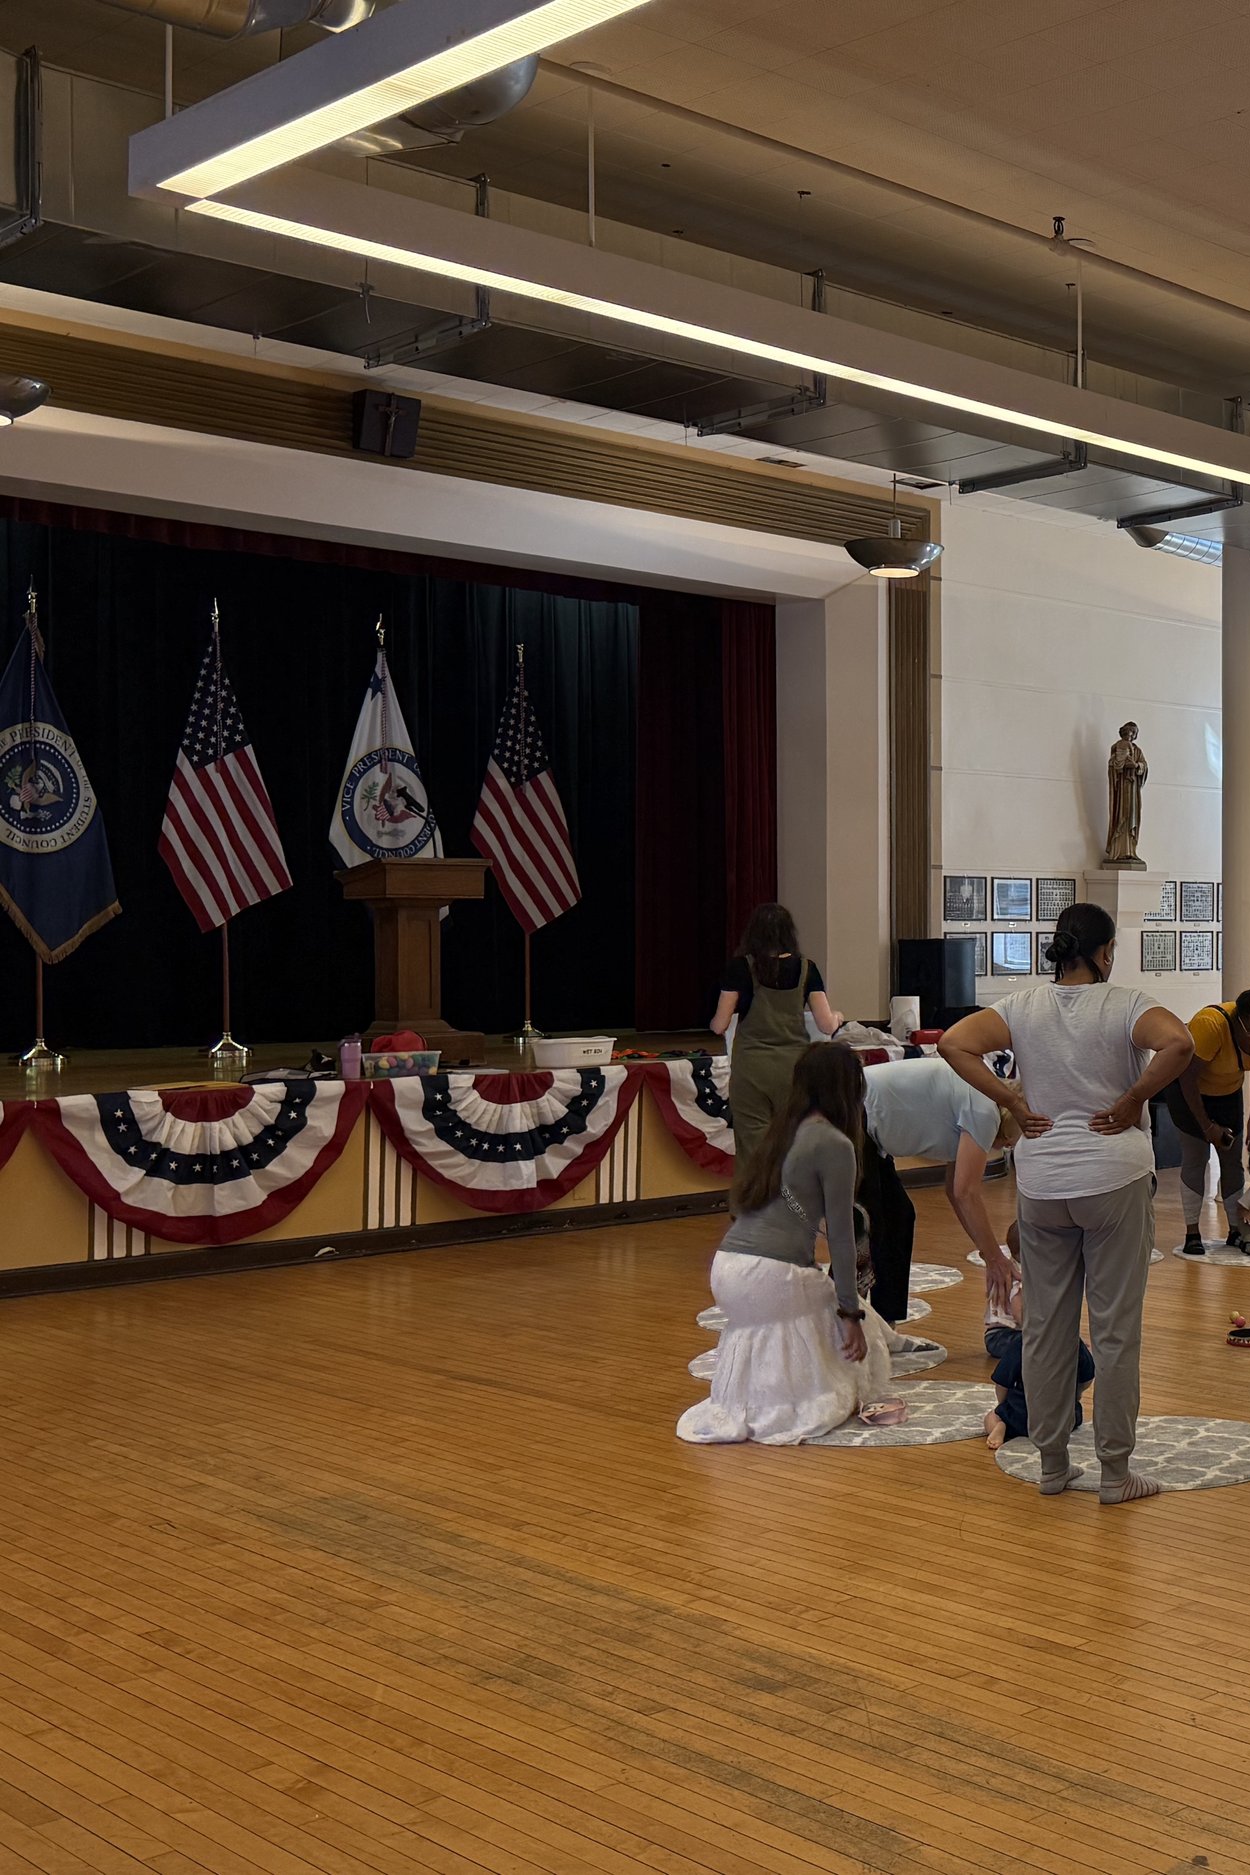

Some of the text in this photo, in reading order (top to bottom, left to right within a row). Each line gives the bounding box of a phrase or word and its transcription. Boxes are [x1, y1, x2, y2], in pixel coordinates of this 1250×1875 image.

[342, 781, 354, 810] VICE
[61, 797, 92, 843] STUDENT
[5, 828, 57, 849] COUNCIL
